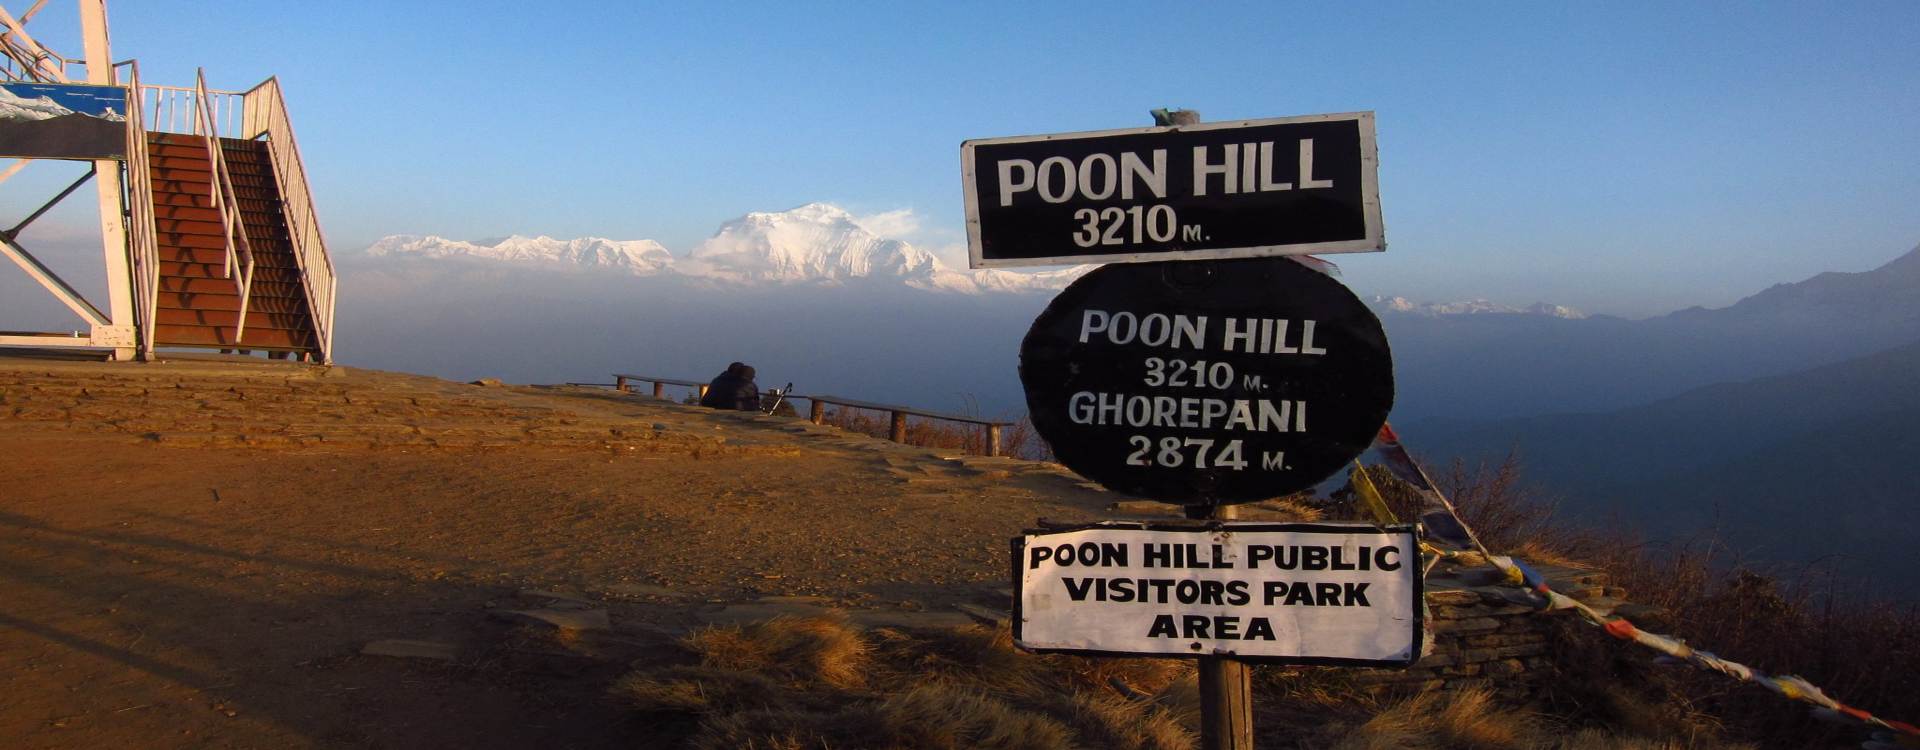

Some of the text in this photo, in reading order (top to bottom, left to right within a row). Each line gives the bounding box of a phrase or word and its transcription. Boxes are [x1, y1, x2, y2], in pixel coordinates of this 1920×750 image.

[997, 138, 1334, 207] POON HILL
[1073, 204, 1177, 248] 3210
[1079, 309, 1327, 355] POON HILL
[1144, 357, 1234, 390] 3210
[1068, 391, 1306, 433] GHOREPANI
[1126, 435, 1248, 471] 2874
[1030, 542, 1402, 572] POON HILL PUBLIC
[1061, 577, 1371, 607] VISITORS PARK
[1147, 614, 1277, 642] AREA
